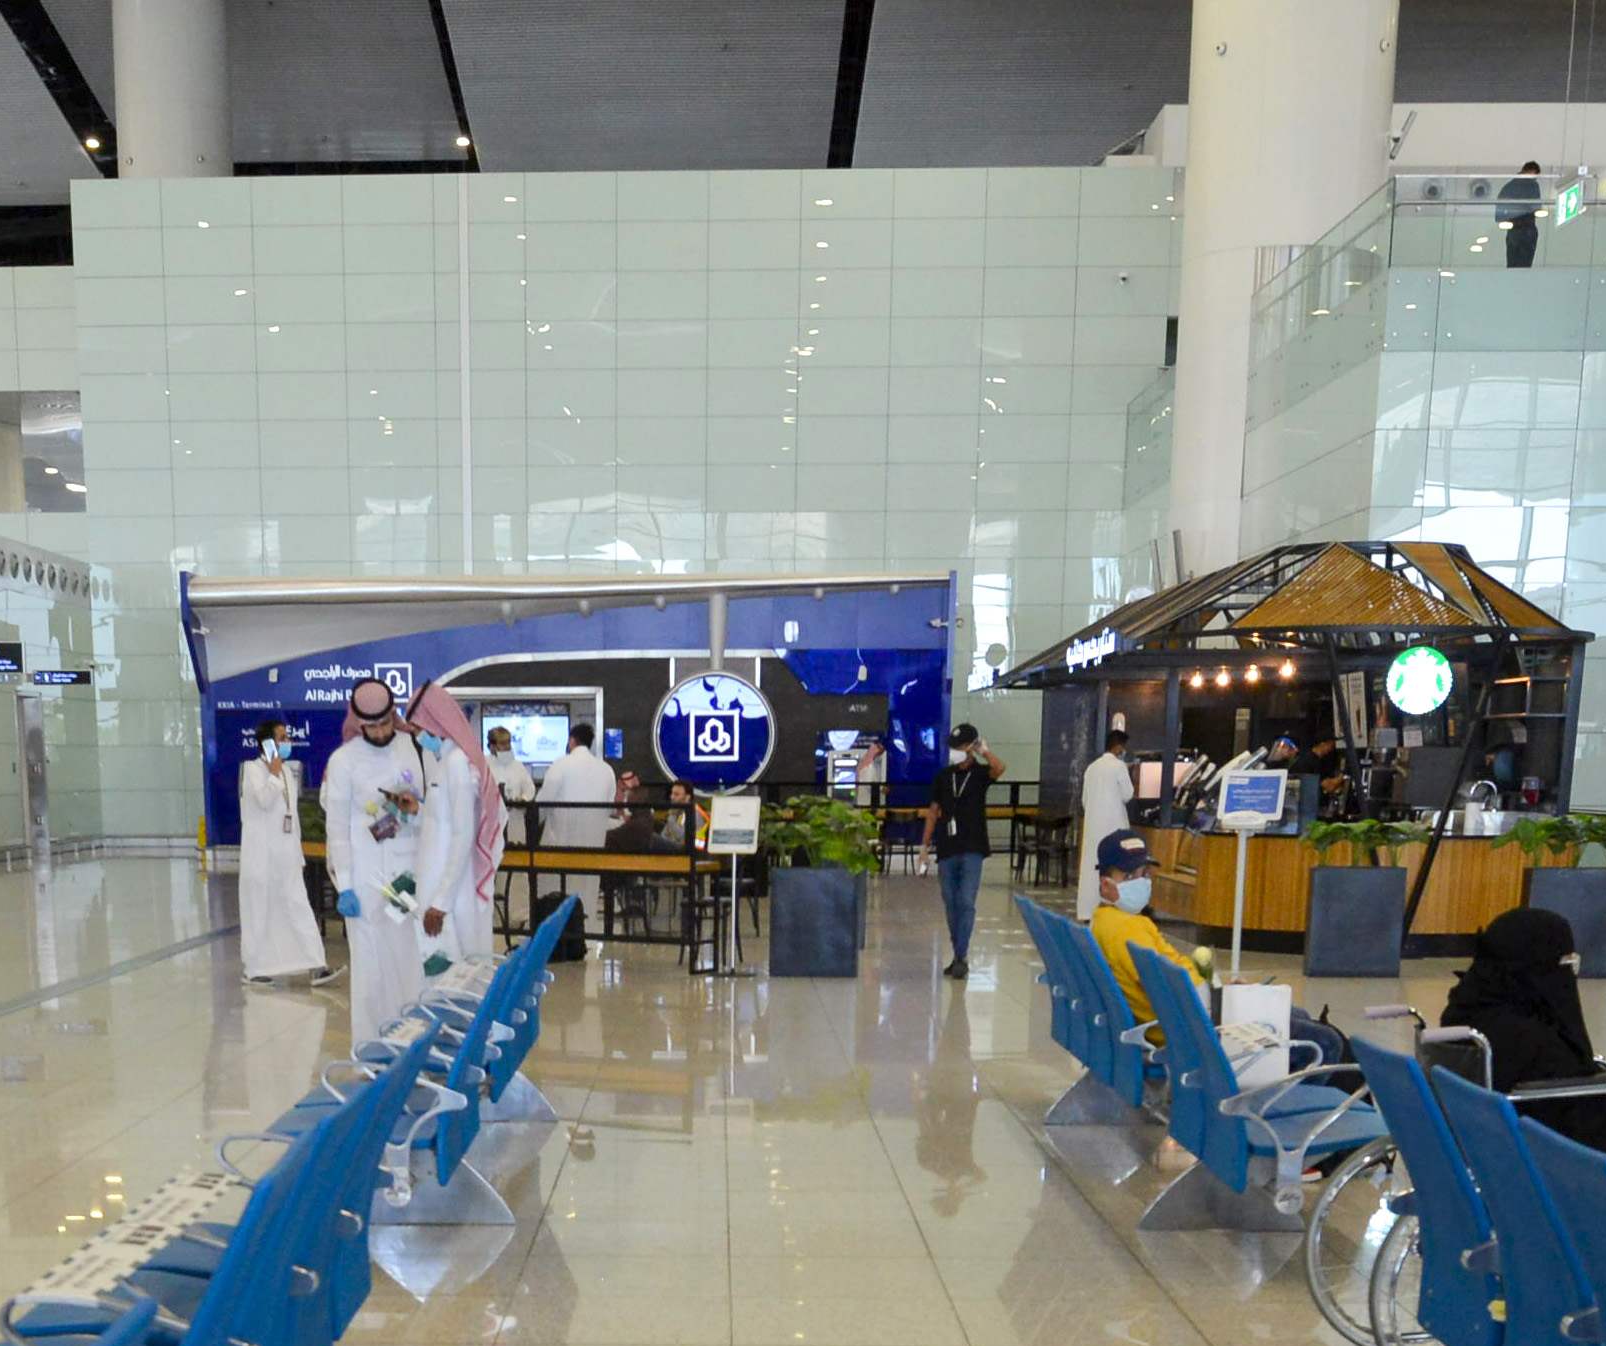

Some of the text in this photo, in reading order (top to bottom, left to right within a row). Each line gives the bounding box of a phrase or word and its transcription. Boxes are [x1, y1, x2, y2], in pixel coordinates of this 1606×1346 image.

[303, 663, 341, 682] الراجحي
[305, 690, 318, 702] Al
[318, 689, 344, 704] Rajhi
[242, 701, 275, 709] Terminal
[849, 703, 869, 713] ATM
